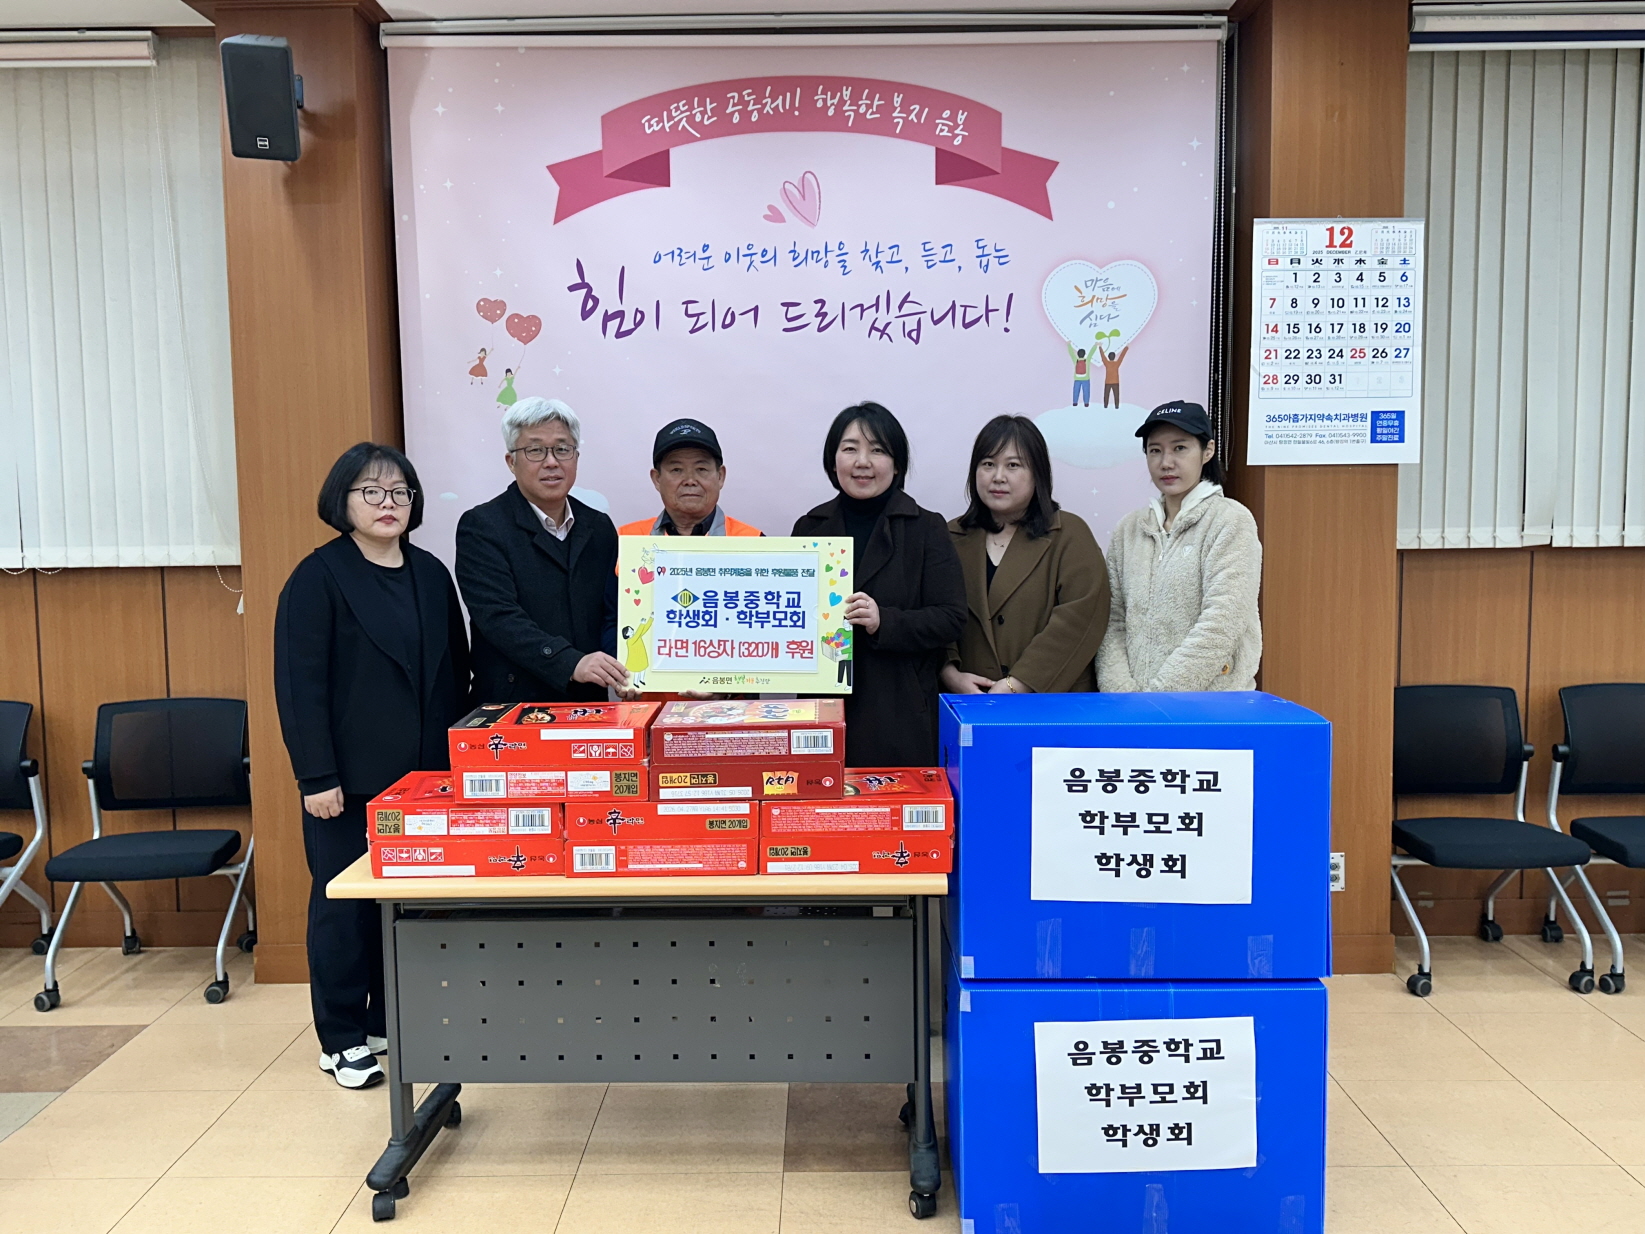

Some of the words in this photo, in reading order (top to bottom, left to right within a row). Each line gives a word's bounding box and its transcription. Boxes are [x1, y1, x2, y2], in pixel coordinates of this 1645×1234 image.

[641, 95, 717, 138] 따뜻한
[725, 86, 802, 123] 공동체!
[813, 85, 885, 127] 행복한
[891, 92, 928, 134] 복지
[935, 110, 969, 146] 음봉
[1325, 226, 1354, 248] 12
[653, 241, 716, 271] 어려운
[723, 241, 779, 273] 이웃의
[788, 241, 851, 277] 희망을
[860, 241, 909, 275] 찾고,
[920, 241, 962, 274] 듣고,
[974, 238, 1012, 275] 돕는
[1292, 272, 1298, 283] 1
[1312, 272, 1320, 283] 2
[1334, 272, 1342, 283] 3
[1356, 272, 1364, 283] 4
[1378, 272, 1386, 283] 5
[1400, 272, 1408, 283] 6
[566, 258, 661, 340] 힘이
[681, 296, 760, 336] 되어
[780, 290, 1014, 346] 드리겠습니다!
[1269, 297, 1276, 308] 7
[1290, 297, 1298, 308] 8
[1312, 297, 1320, 308] 9
[1330, 297, 1345, 308] 10
[1353, 297, 1366, 308] 11
[1374, 297, 1389, 308] 12
[1397, 297, 1411, 308] 13
[1265, 323, 1279, 334] 14
[1286, 323, 1300, 334] 15
[1308, 323, 1322, 334] 16
[1330, 323, 1344, 334] 17
[1352, 323, 1366, 334] 18
[1374, 323, 1388, 334] 19
[1395, 323, 1411, 334] 20
[1264, 348, 1278, 359] 21
[1284, 348, 1300, 359] 22
[1306, 348, 1322, 359] 23
[1328, 348, 1344, 359] 24
[1350, 348, 1366, 359] 25
[1372, 348, 1388, 359] 26
[1394, 348, 1410, 359] 27
[1263, 374, 1279, 385] 28
[1284, 374, 1300, 385] 29
[1305, 374, 1322, 385] 30
[1329, 374, 1342, 385] 31
[669, 568, 693, 576] 2025년
[695, 568, 716, 576] 음봉면
[801, 568, 816, 577] 전달
[702, 590, 801, 609] 음봉중학교
[666, 609, 718, 628] 학생회
[736, 610, 806, 629] 학부모회
[657, 639, 689, 658] 라면
[691, 640, 735, 659] 16상자
[785, 641, 814, 659] 후원
[712, 676, 733, 684] 음봉면
[614, 772, 639, 783] 봉지면
[661, 775, 688, 784] 20개입
[690, 774, 716, 784] 봉지면
[765, 774, 794, 786] 너구리
[1062, 767, 1222, 795] 음봉중학교
[614, 784, 639, 795] 20개입
[377, 810, 401, 821] 20개입
[377, 823, 401, 834] 봉지면
[708, 820, 726, 829] 봉지면
[728, 819, 748, 829] 20개입
[1078, 810, 1205, 837] 학부모회
[768, 847, 788, 856] 20개입
[790, 847, 810, 856] 봉지면
[1094, 851, 1188, 880] 학생회
[1067, 1038, 1225, 1067] 음봉중학교
[1084, 1080, 1209, 1108] 학부모회
[1101, 1121, 1194, 1149] 학생회
